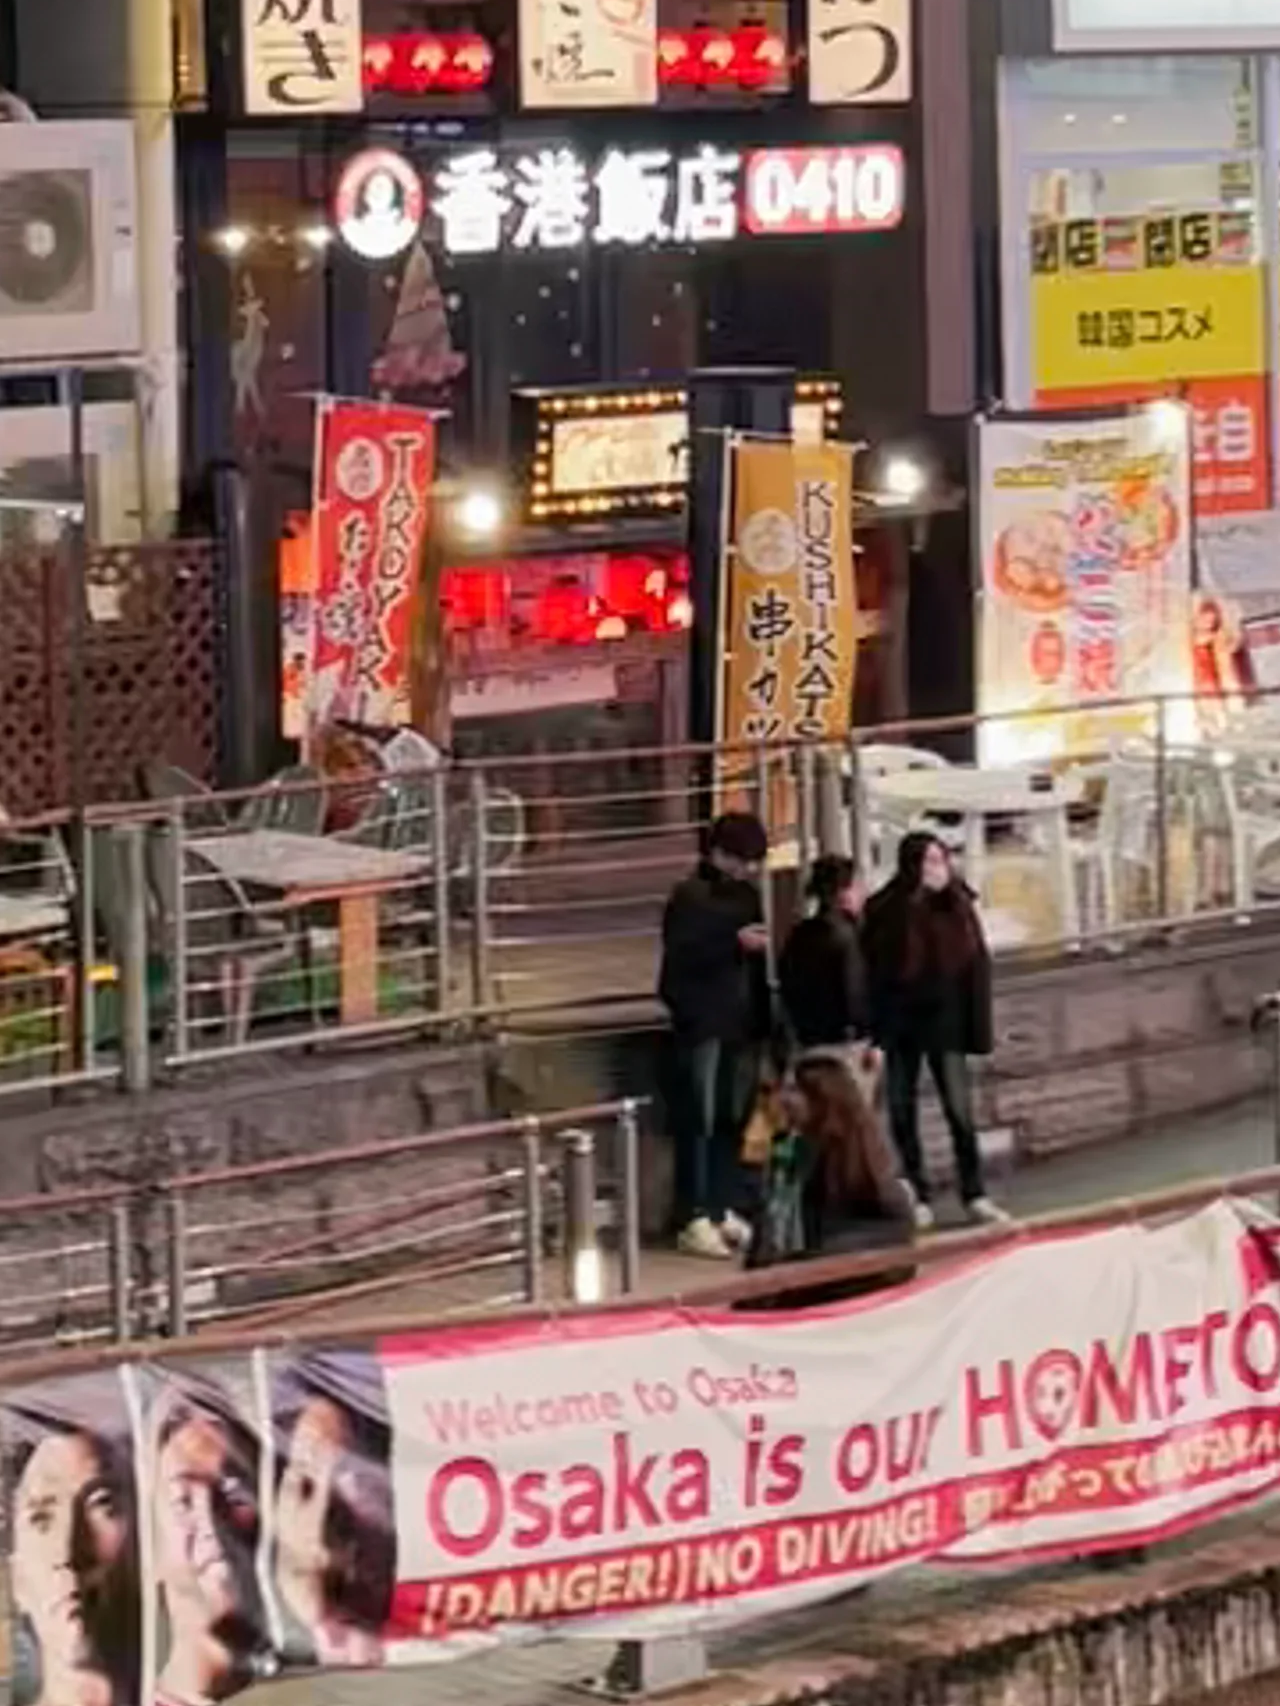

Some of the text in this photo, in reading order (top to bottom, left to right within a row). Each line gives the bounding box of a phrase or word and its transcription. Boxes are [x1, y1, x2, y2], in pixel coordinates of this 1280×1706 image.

[432, 147, 902, 254] 香港飯店 0410
[747, 586, 794, 736] 串カツ
[425, 1362, 799, 1444] Welcome to Osaka
[427, 1431, 710, 1558] Osaka
[743, 1412, 806, 1508] is
[835, 1404, 944, 1494] our
[696, 1538, 764, 1586] NO
[775, 1491, 940, 1564] DIVING!
